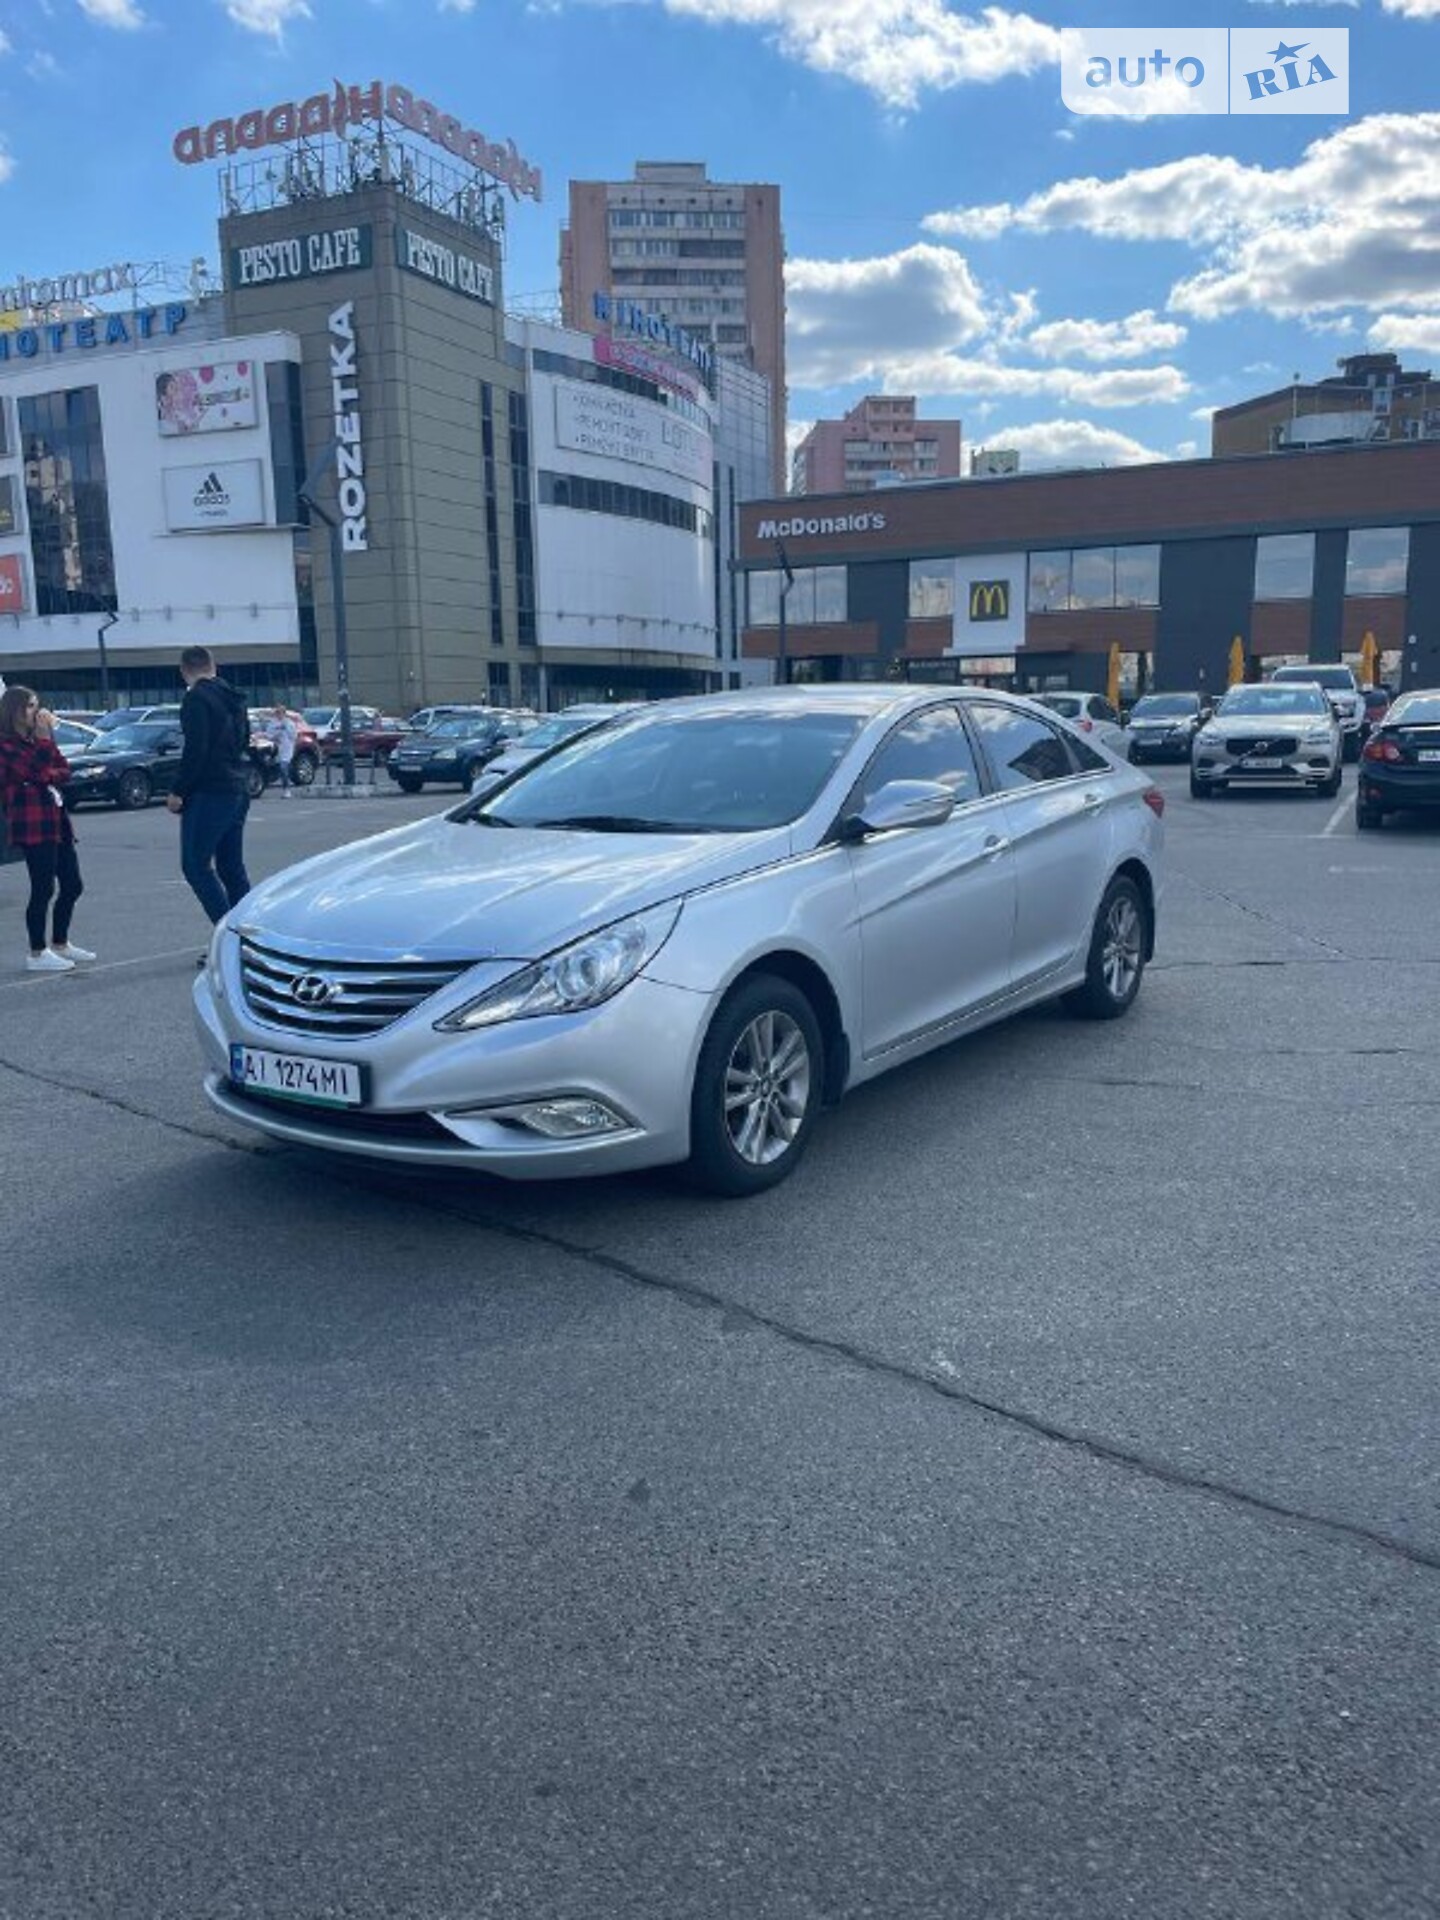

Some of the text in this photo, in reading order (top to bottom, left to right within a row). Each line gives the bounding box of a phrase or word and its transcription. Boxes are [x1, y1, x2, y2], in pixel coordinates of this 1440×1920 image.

[239, 227, 360, 284] PESTO CAFE
[406, 230, 493, 301] PESTO CAFE
[329, 301, 368, 550] ROZETKA
[757, 511, 886, 538] McDonald's
